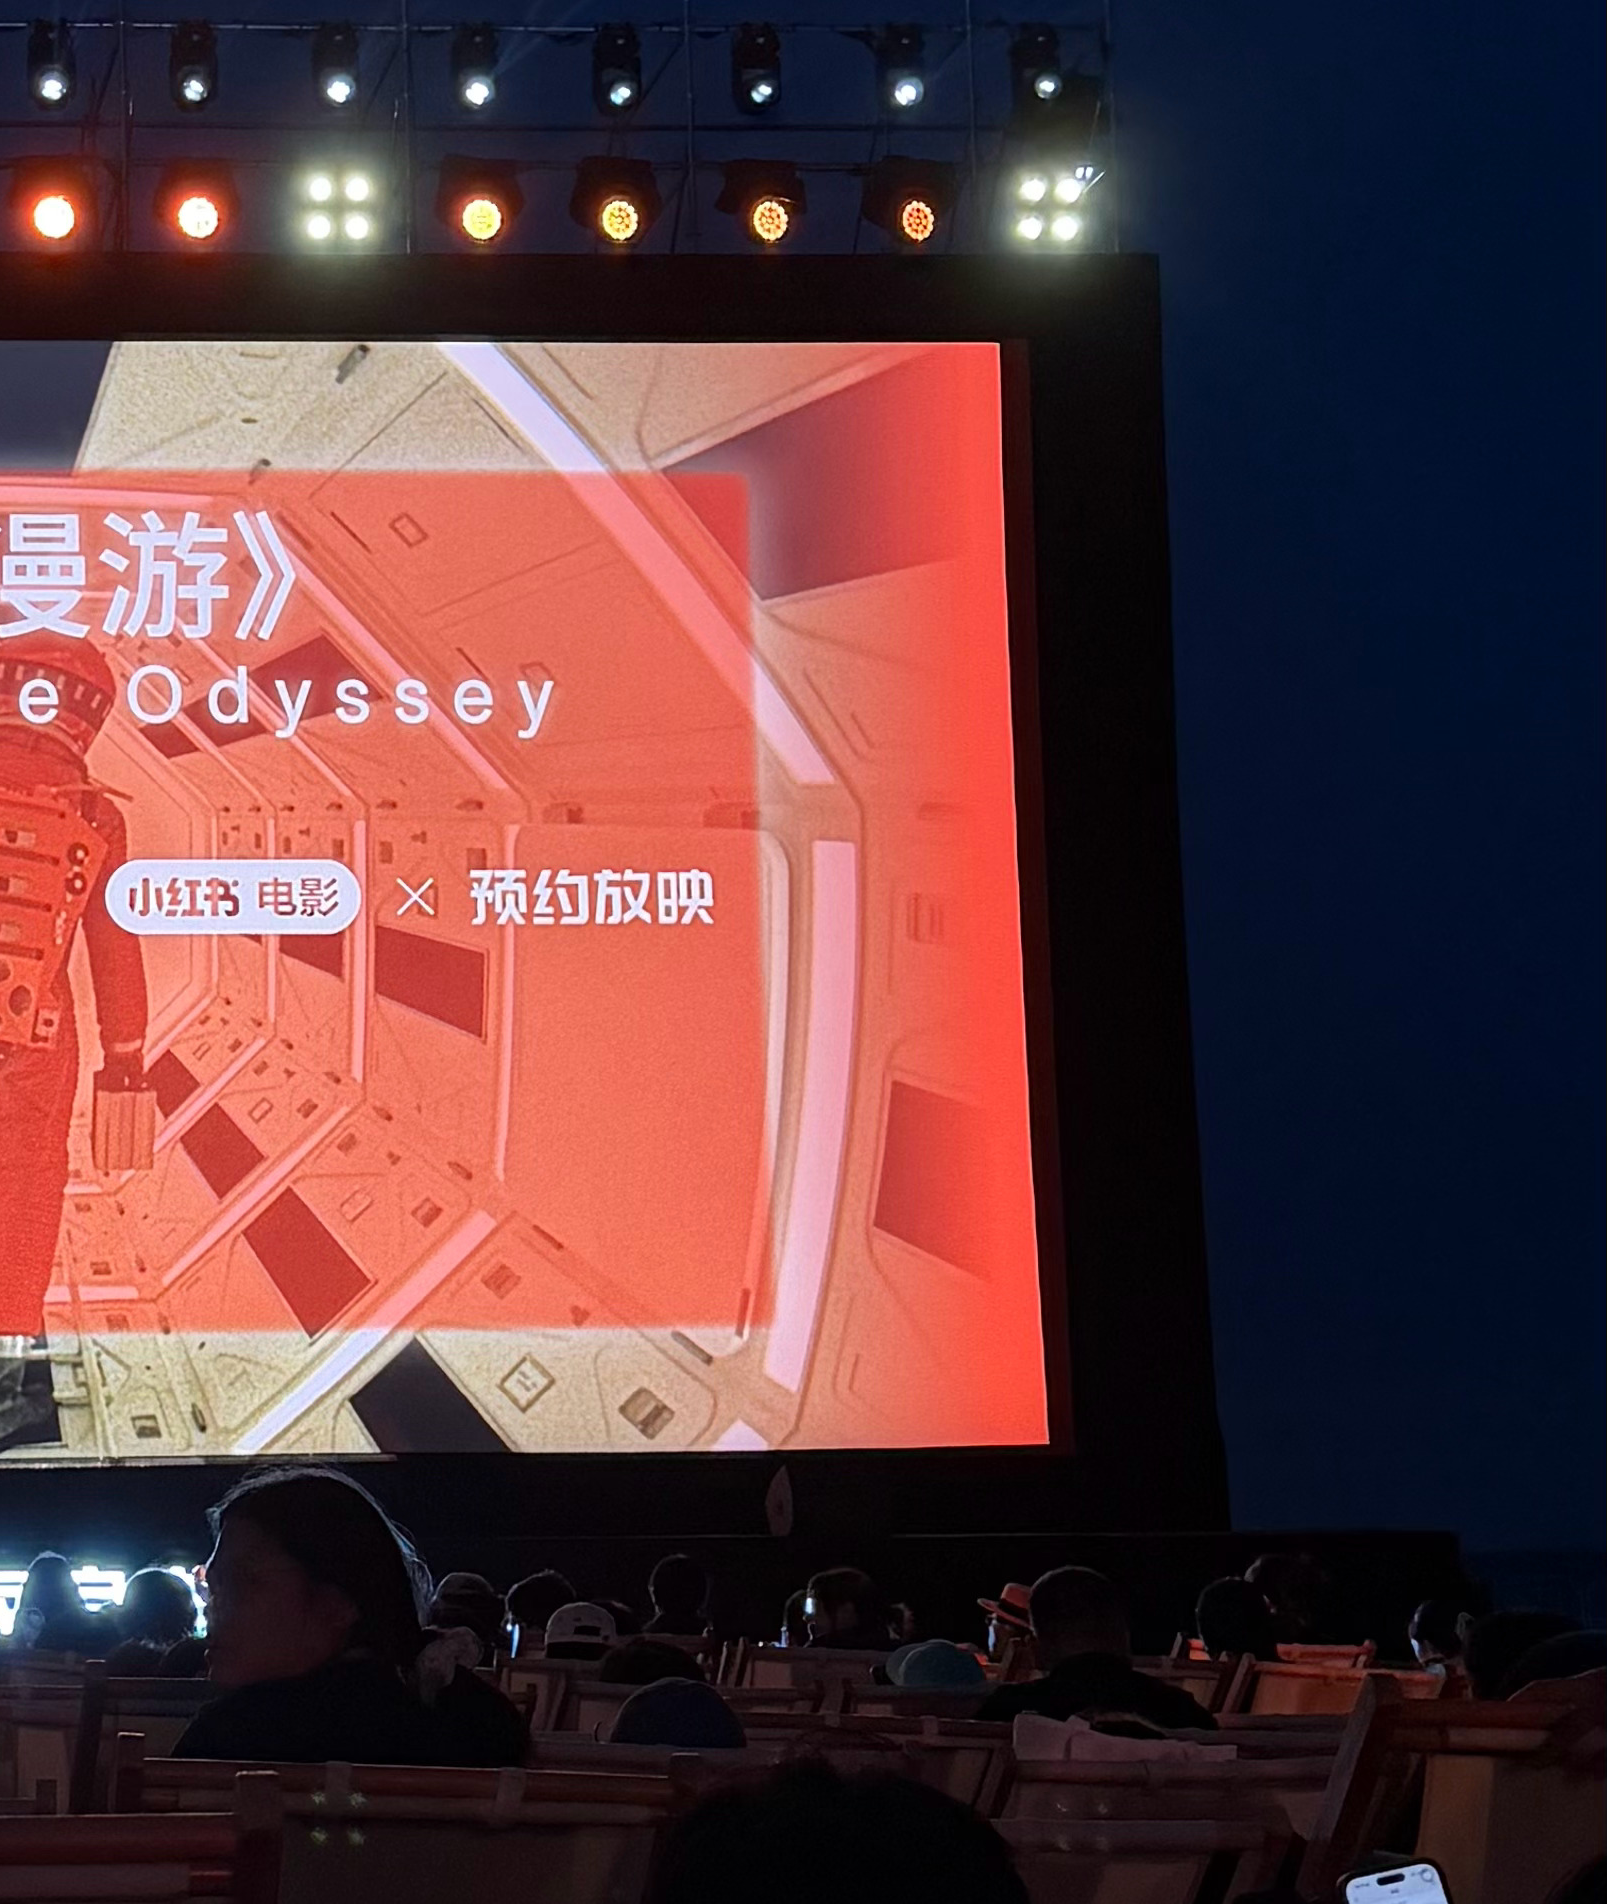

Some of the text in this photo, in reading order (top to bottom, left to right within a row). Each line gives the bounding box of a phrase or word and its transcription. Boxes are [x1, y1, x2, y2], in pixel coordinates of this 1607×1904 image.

[126, 664, 554, 740] Odyssey
[128, 877, 241, 918] 小红书
[258, 876, 340, 918] 电影
[468, 867, 715, 926] 预约放映
